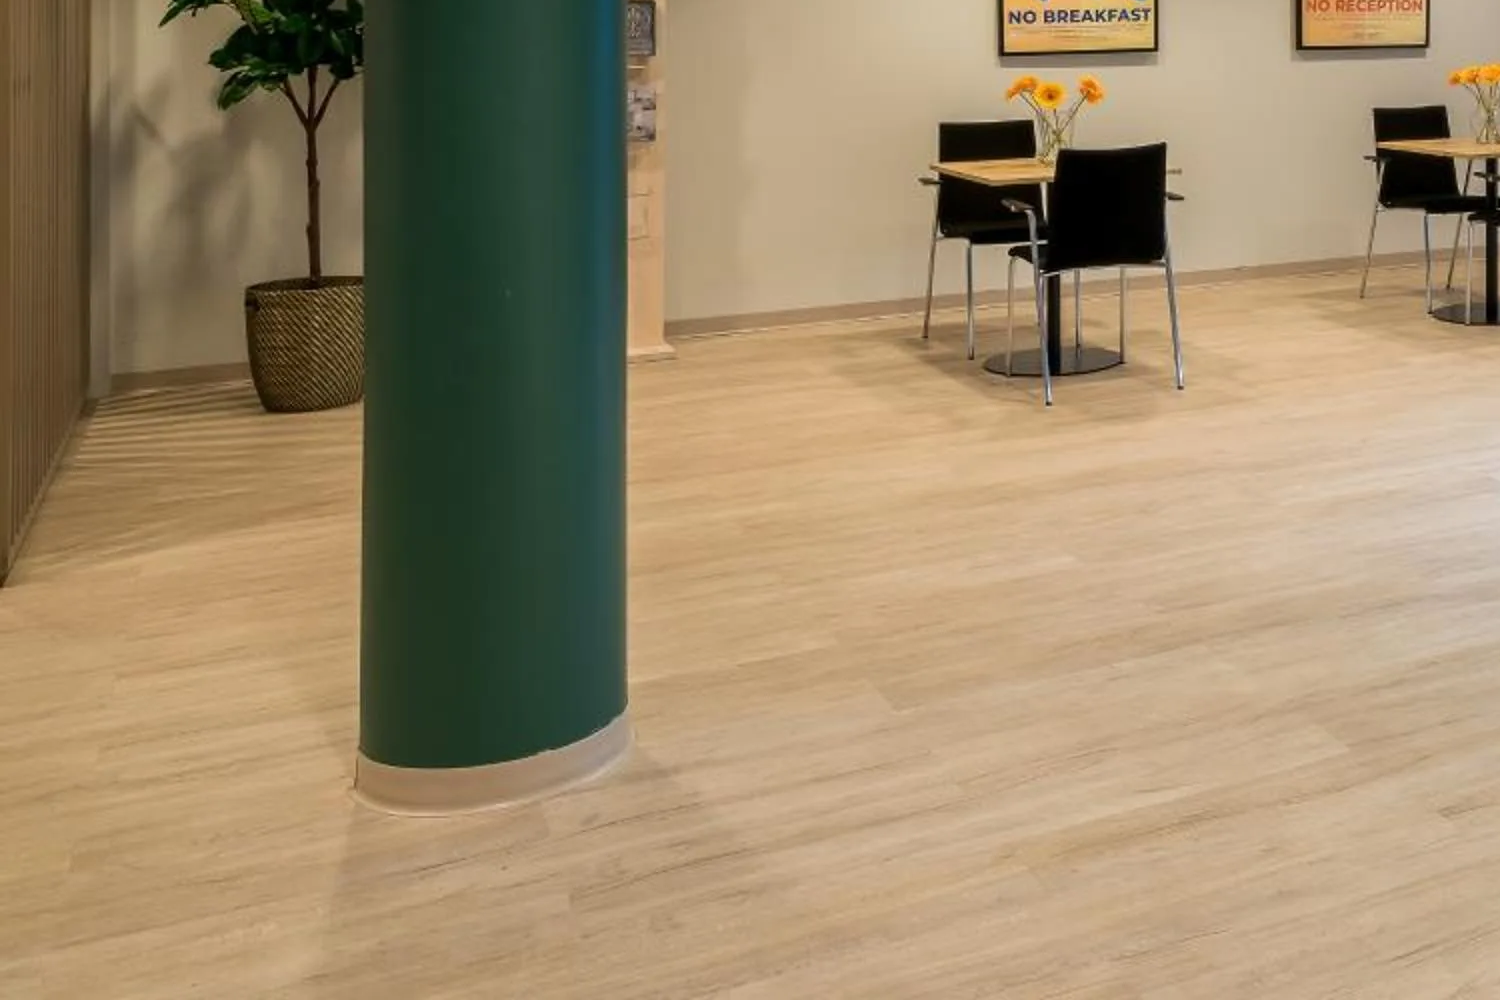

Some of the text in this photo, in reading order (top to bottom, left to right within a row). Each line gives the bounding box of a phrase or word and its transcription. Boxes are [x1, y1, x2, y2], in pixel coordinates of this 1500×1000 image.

[1307, 0, 1423, 12] NO RECEPTION
[1008, 8, 1152, 24] NO BREAKFAST
